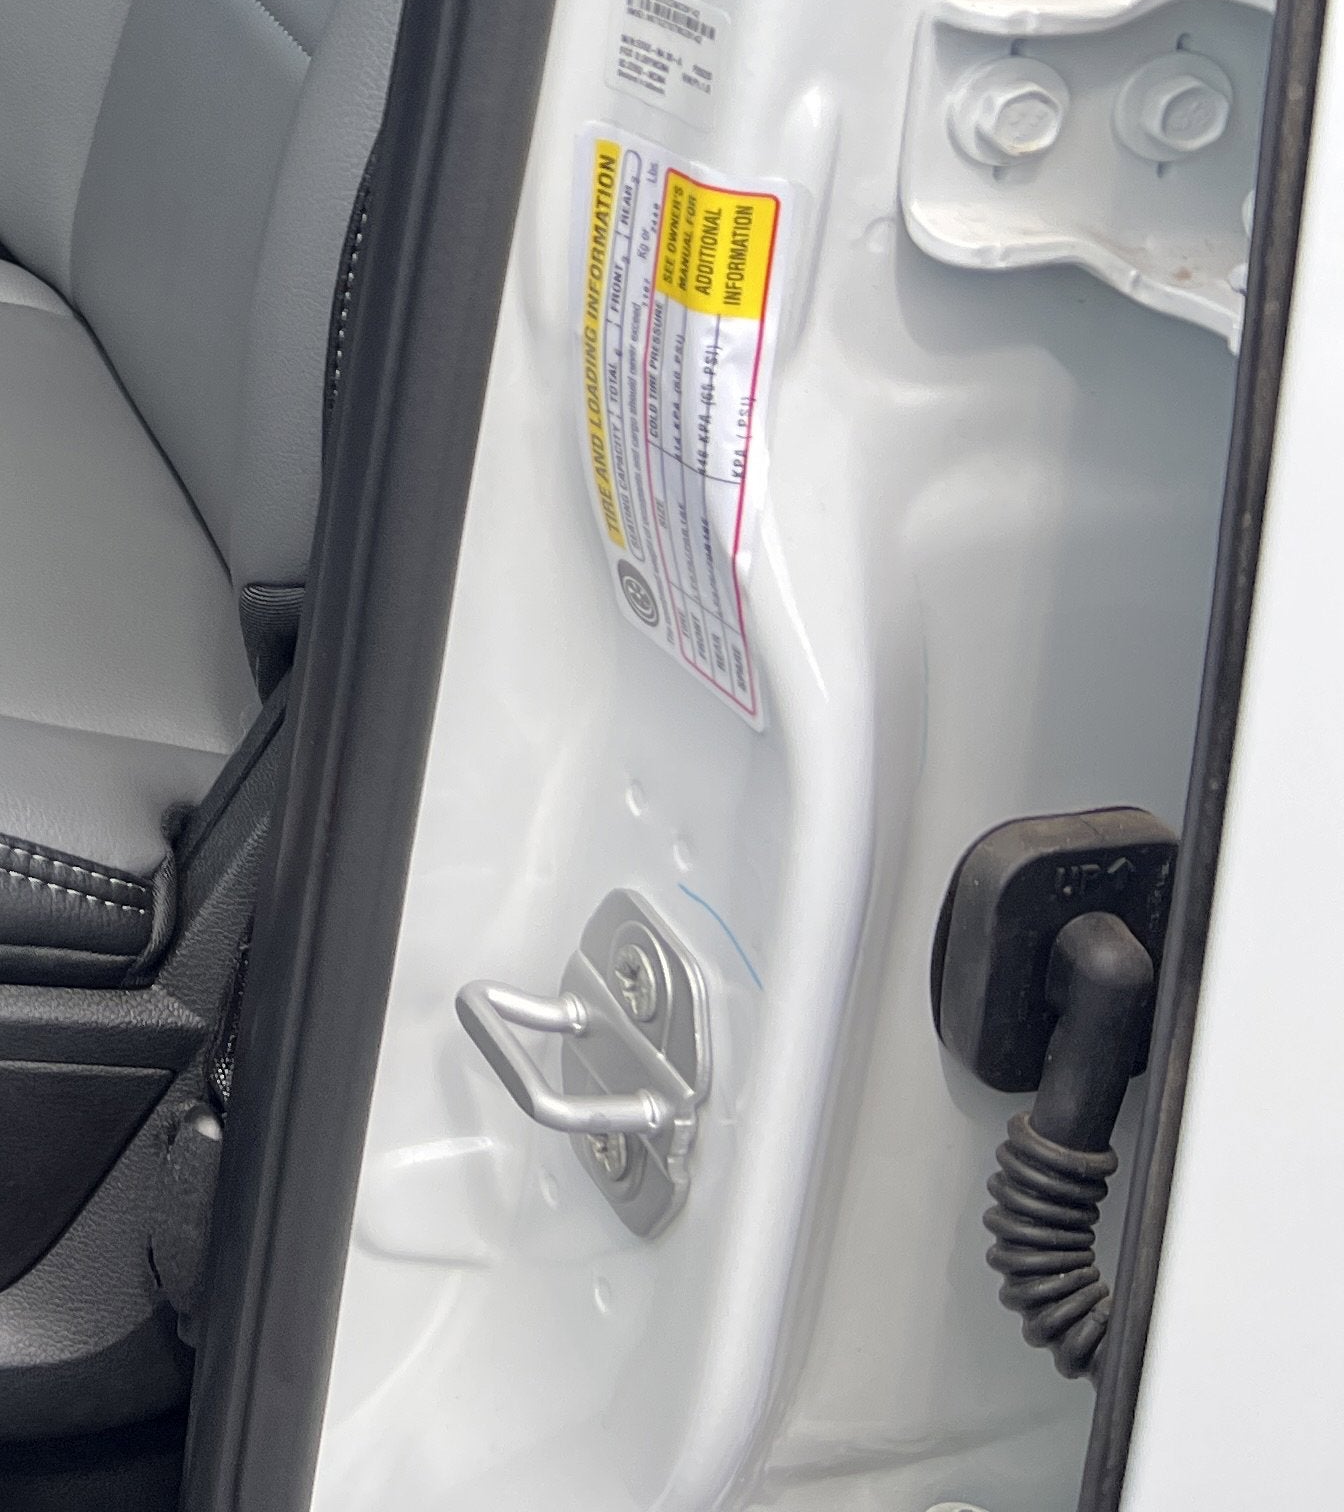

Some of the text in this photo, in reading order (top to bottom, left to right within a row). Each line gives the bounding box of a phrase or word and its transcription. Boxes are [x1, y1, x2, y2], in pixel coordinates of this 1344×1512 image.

[620, 184, 632, 226] REAR
[662, 183, 684, 284] SEE OWNER'S
[678, 192, 698, 292] MANUAL FOR
[693, 206, 723, 297] ADDITIONAL
[722, 204, 755, 306] INFORMATION
[610, 263, 623, 314] FRONT
[583, 154, 620, 532] TIRE AND LOADING INFORMATION
[630, 301, 642, 343] exceed
[648, 301, 663, 370] PRESSURE
[608, 362, 618, 403] TOTAL
[629, 344, 638, 375] never
[627, 375, 638, 415] should
[648, 404, 658, 439] COLD
[698, 413, 711, 444] KPA
[612, 423, 628, 491] CAPACITY
[731, 448, 747, 478] KPA
